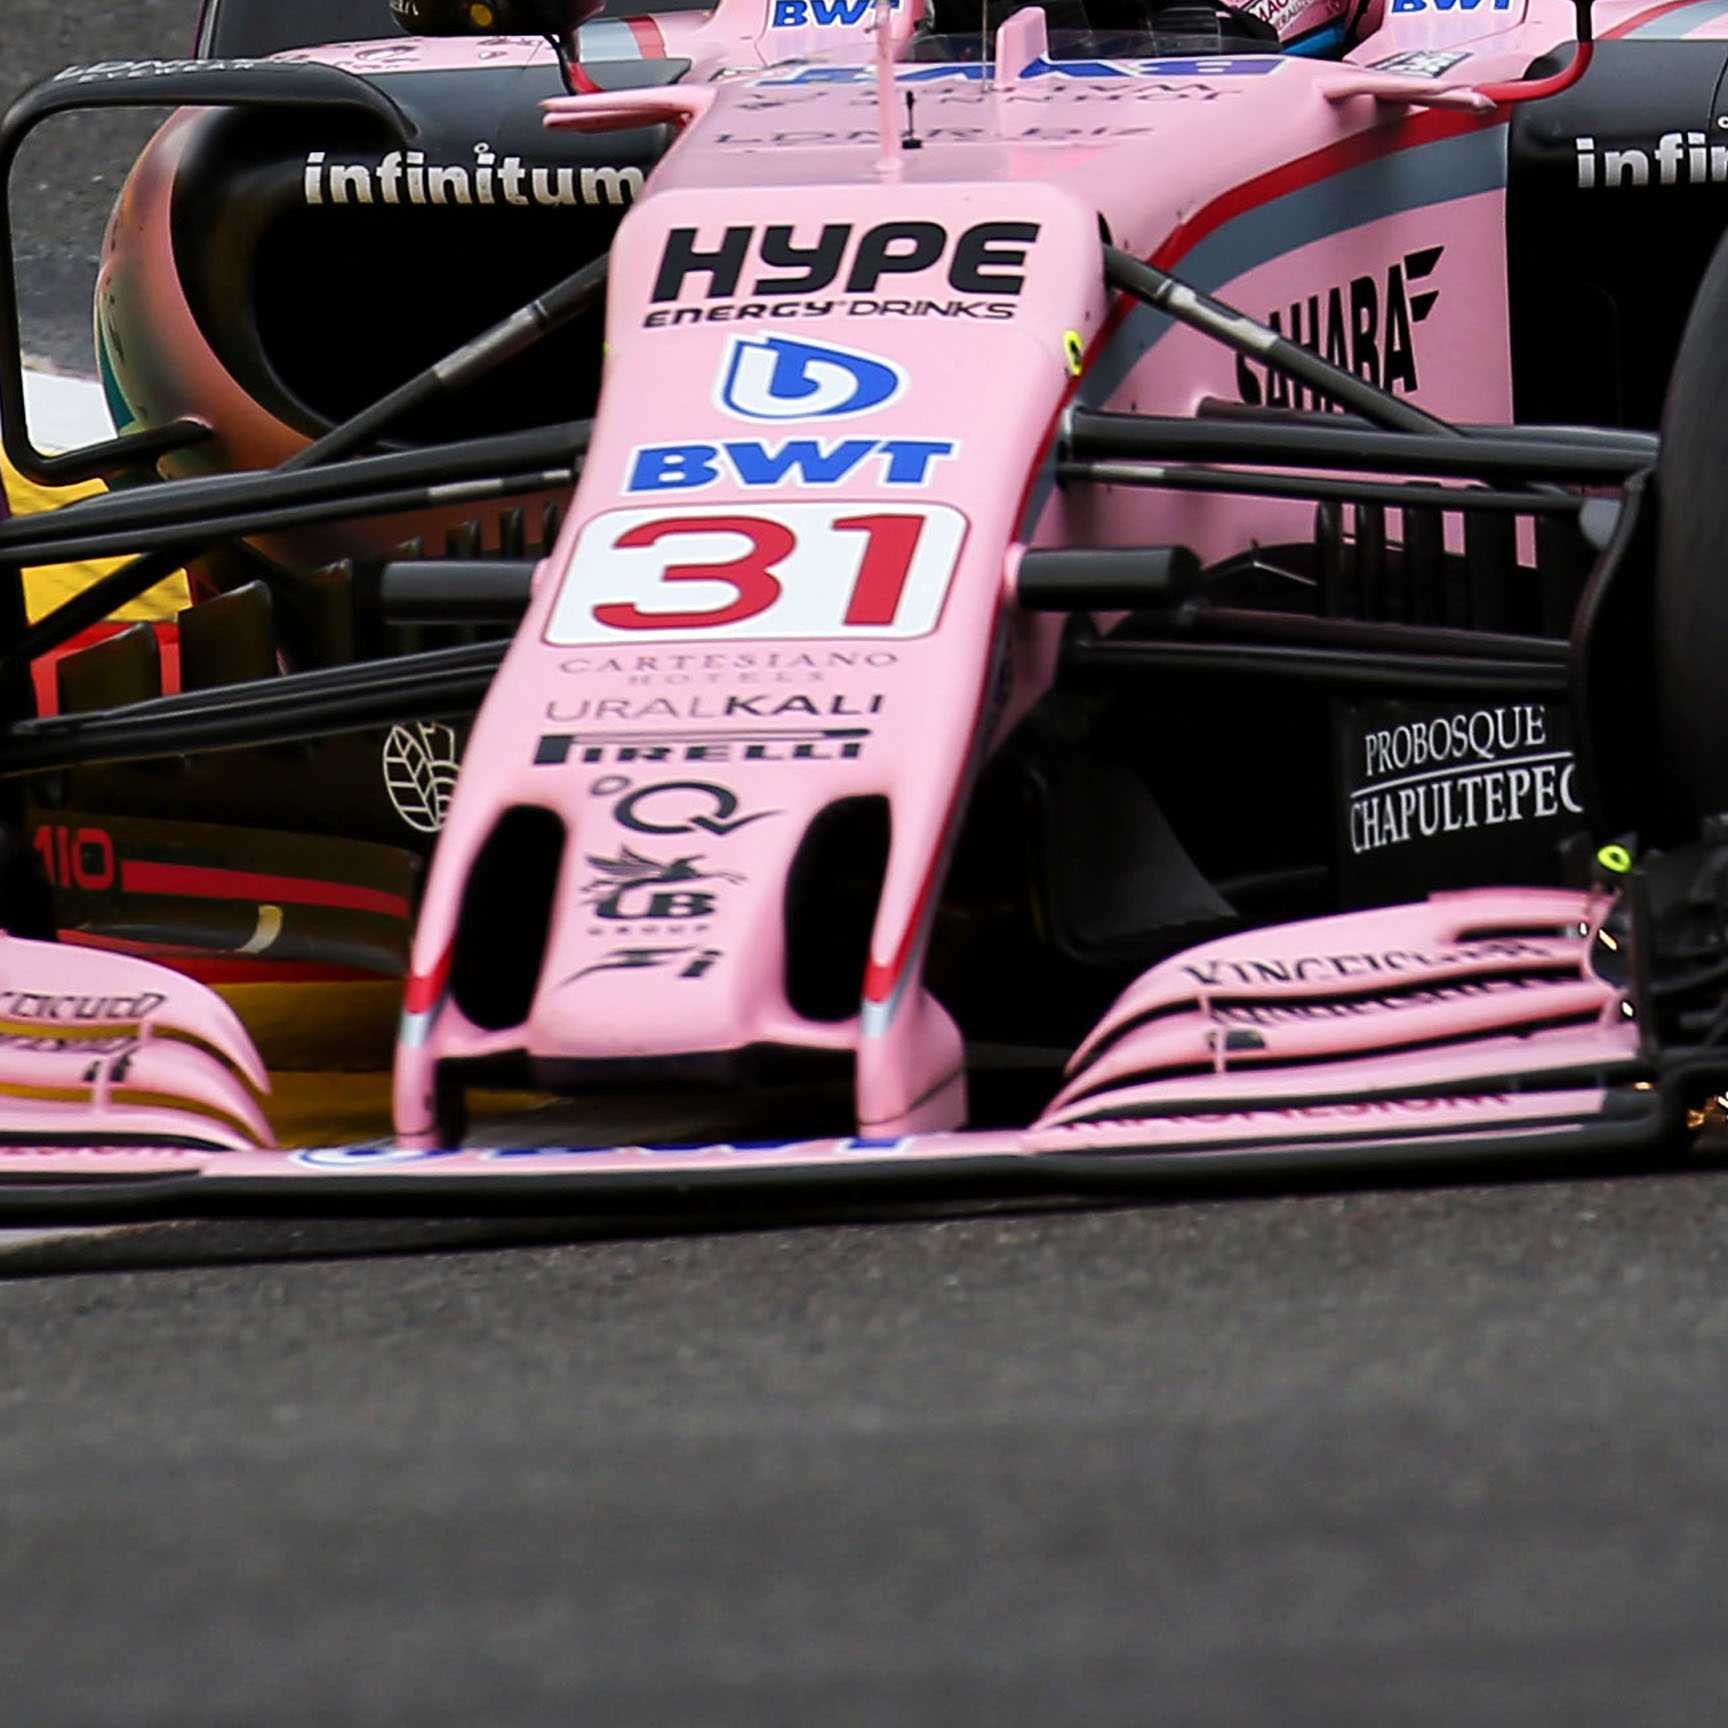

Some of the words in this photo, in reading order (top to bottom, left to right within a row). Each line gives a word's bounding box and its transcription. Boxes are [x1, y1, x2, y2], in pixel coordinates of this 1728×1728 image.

[304, 148, 646, 205] infinitum
[649, 222, 1042, 304] HYPE
[642, 301, 835, 328] ENERGY
[845, 299, 1017, 321] DRINKS
[627, 439, 954, 493] BWT
[592, 513, 927, 631] 31
[558, 650, 900, 674] CARTESIANO
[546, 694, 886, 723] URALKALI
[532, 728, 873, 766] PIRELLI
[1365, 704, 1547, 776] PROBOSQUE
[1350, 763, 1585, 854] CHAPULTEPEC
